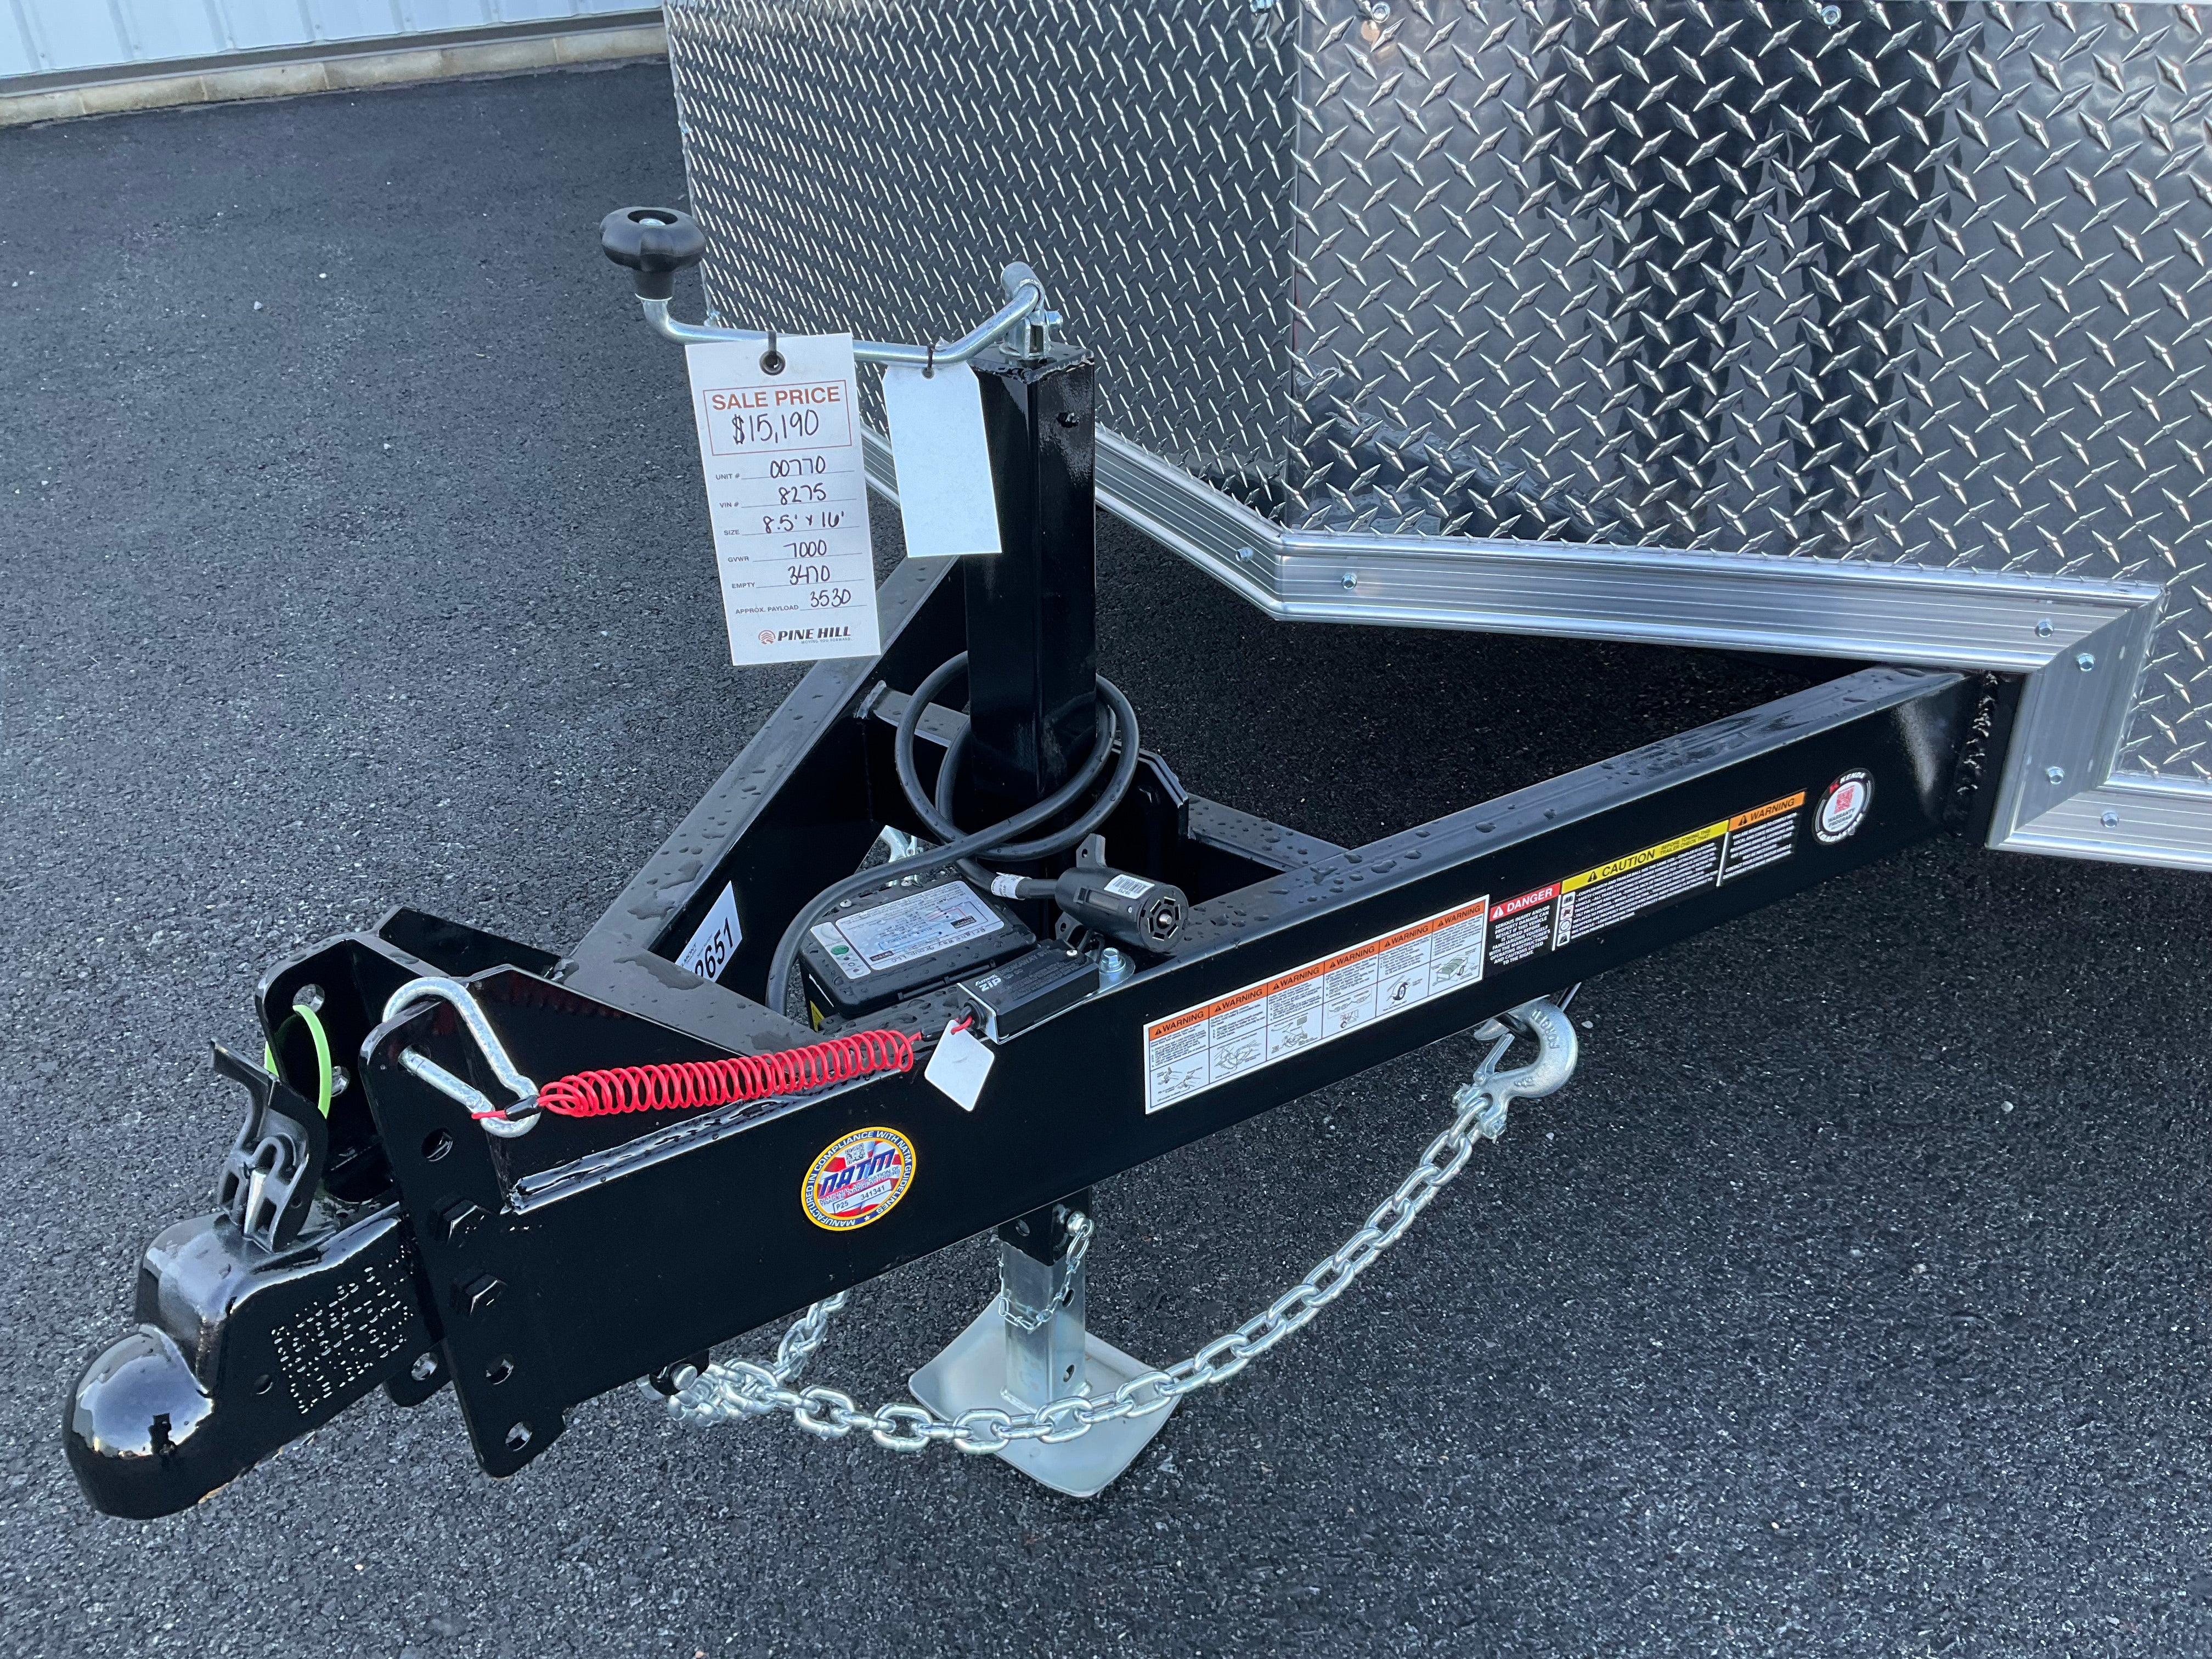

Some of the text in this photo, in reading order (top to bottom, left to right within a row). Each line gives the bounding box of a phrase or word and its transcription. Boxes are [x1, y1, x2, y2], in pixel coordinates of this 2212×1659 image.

[712, 386, 841, 410] SALE PRICE
[732, 409, 819, 445] $15,190
[769, 455, 826, 479] 00770
[779, 483, 827, 505] 8275
[724, 528, 740, 537] SIZE
[763, 514, 798, 534] 8.5'
[783, 539, 827, 558] 7000
[788, 565, 831, 586] 3470
[810, 588, 851, 608] 3530
[778, 626, 851, 641] PINE HILL
[1839, 772, 1865, 784] KENDA
[1751, 798, 1795, 821] WARNING
[1660, 844, 1680, 855] TRAILER
[1680, 838, 1696, 848] CHECK
[1661, 839, 1679, 850] BEFORE
[1602, 849, 1656, 877] CAUTION
[1507, 888, 1553, 912] DANGER
[1444, 905, 1481, 924] WARNING
[1494, 922, 1518, 935] PROPERTY
[1519, 915, 1538, 926] DAMAGE
[1495, 904, 1550, 929] SERIOUS INJURY AND/OR
[1391, 925, 1429, 944] WARNING
[1492, 925, 1548, 950] FAMILIARIZING YOURSELF
[1496, 929, 1511, 939] RESULT
[1528, 916, 1547, 926] VEHICLE
[1506, 930, 1522, 939] TOWED
[1523, 923, 1540, 933] BEFORE
[1337, 946, 1375, 966] WARNING
[1489, 934, 1548, 960] OPERATING INSTRUCTIONS
[1504, 947, 1527, 960] CAUTIONS
[1528, 941, 1543, 951] LISTED
[1280, 967, 1320, 987] WARNING
[1222, 989, 1263, 1008] WARNING
[1163, 1011, 1204, 1032] WARNING
[805, 1131, 912, 1227] MANUFACTURED IN COMPLIANCE WITH NATM GUIDELINES
[820, 1188, 851, 1204] NATIONAL
[853, 1170, 891, 1188] ASSOCIATION
[820, 1170, 901, 1206] TRAILER MANUFACTURERS
[836, 1185, 885, 1210] P25 341341
